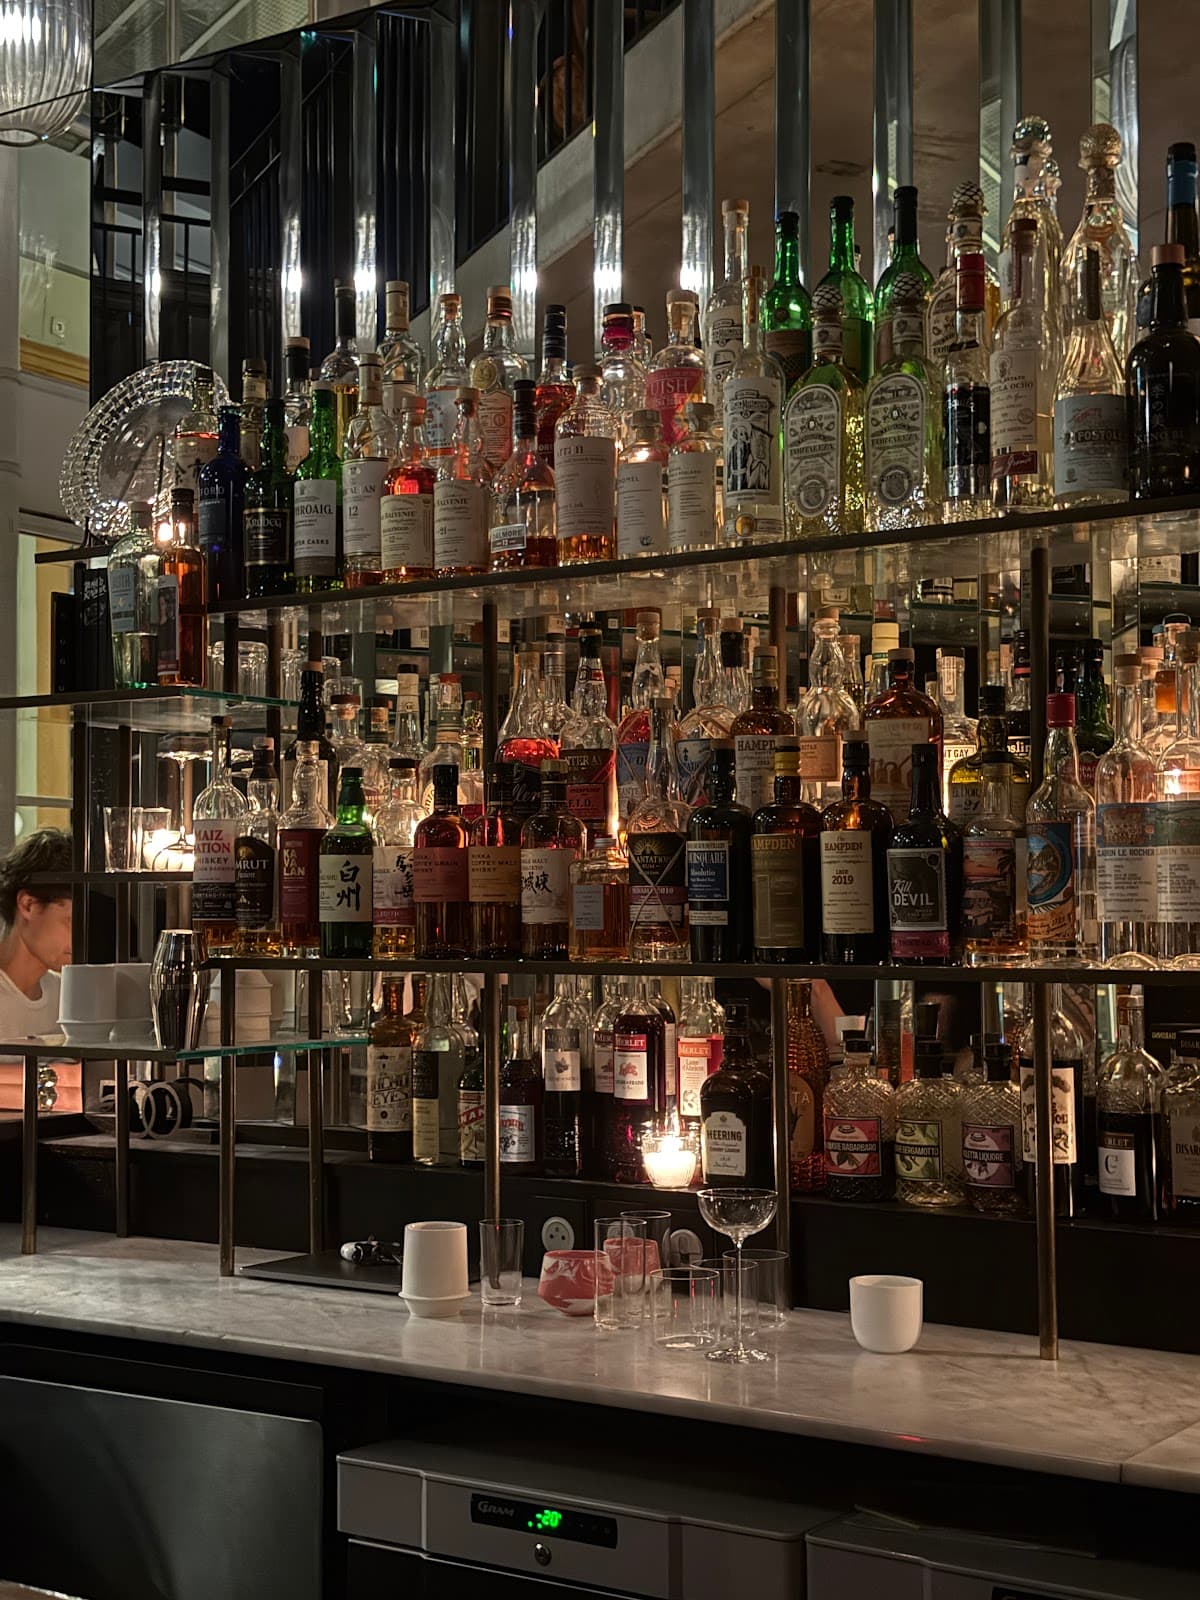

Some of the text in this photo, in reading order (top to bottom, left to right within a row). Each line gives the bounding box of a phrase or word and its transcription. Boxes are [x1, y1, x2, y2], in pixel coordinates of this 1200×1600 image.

[349, 505, 360, 517] 12
[953, 749, 970, 758] GAY
[283, 867, 305, 877] LAN
[831, 875, 854, 885] 2019
[336, 860, 361, 912] 白州
[893, 893, 935, 907] DEVIL
[706, 1131, 743, 1142] HEERING
